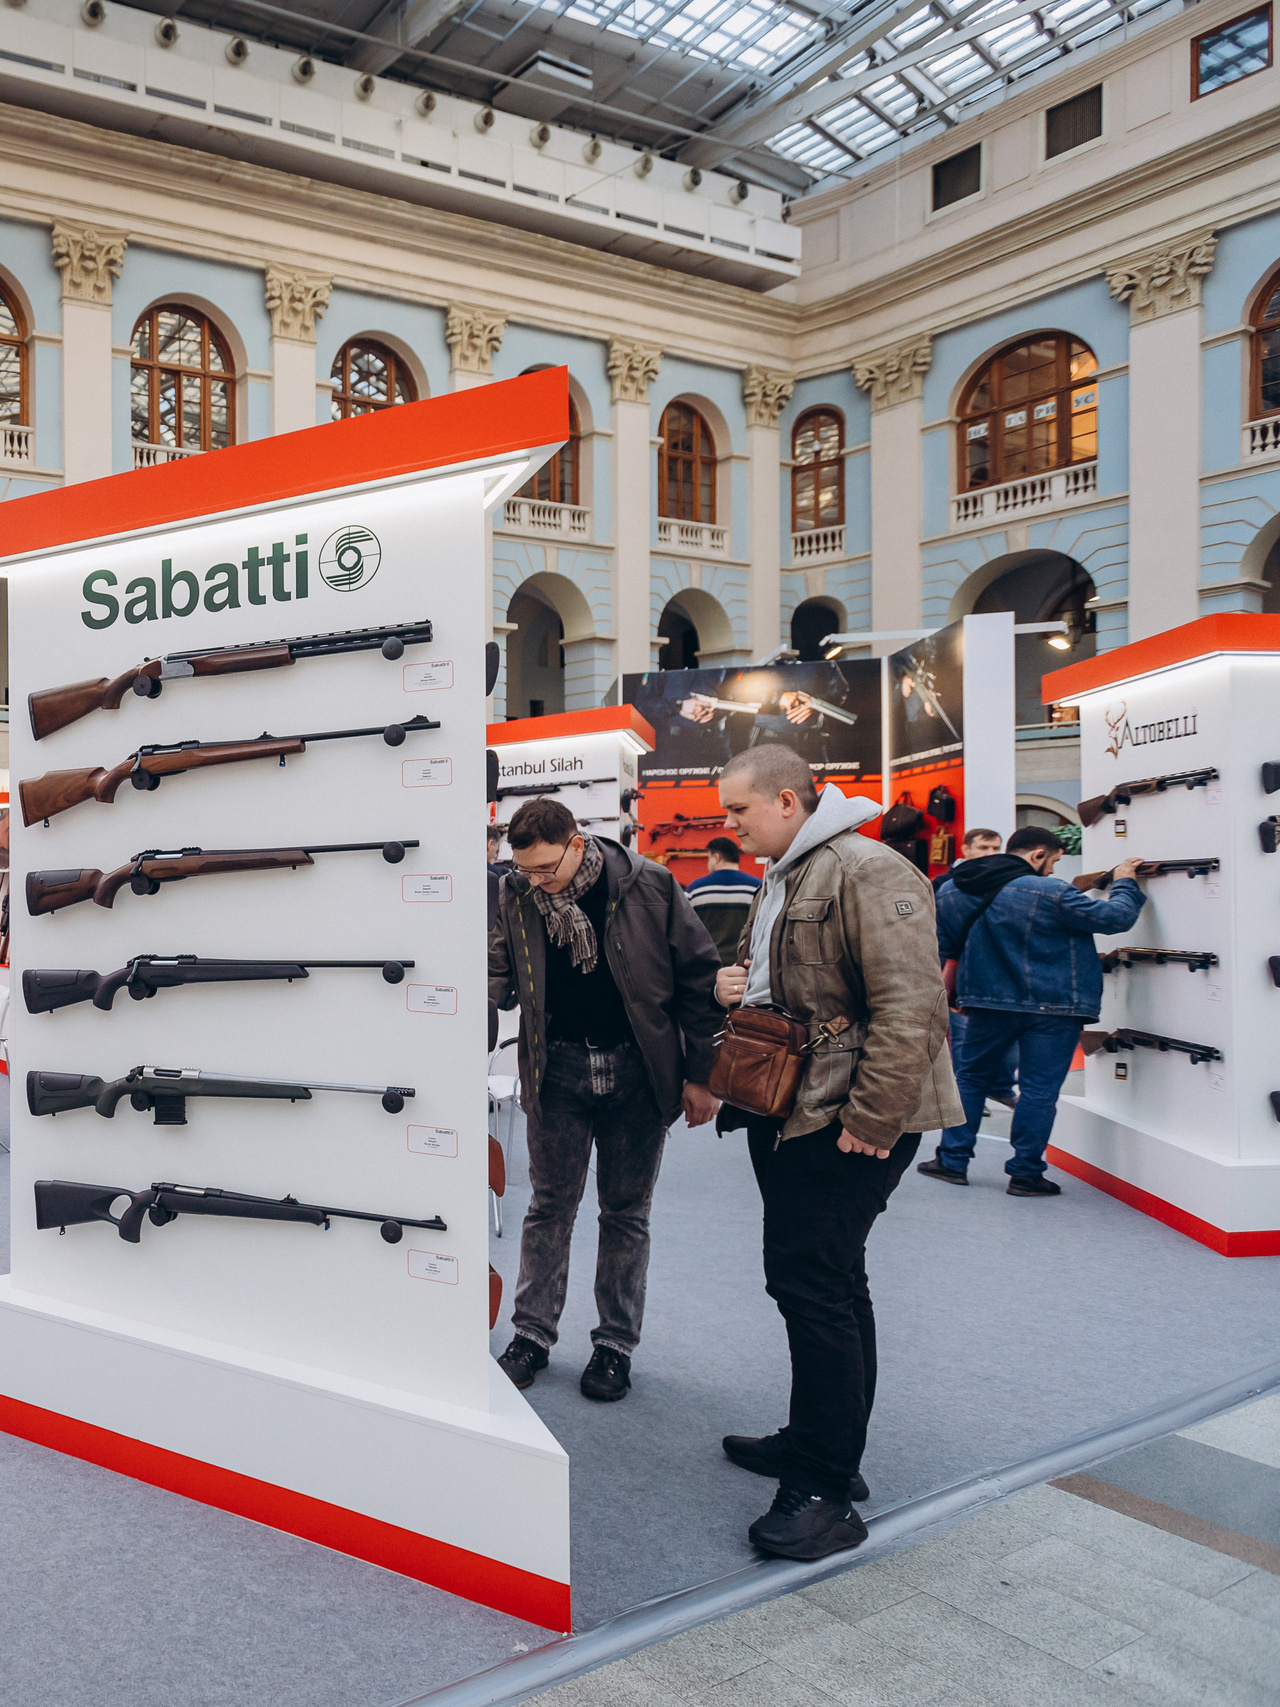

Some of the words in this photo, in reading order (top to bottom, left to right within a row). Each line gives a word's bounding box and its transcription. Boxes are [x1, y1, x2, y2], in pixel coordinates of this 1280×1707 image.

[81, 533, 309, 630] Sabatti
[498, 760, 546, 777] stanbul
[550, 756, 584, 773] Silah
